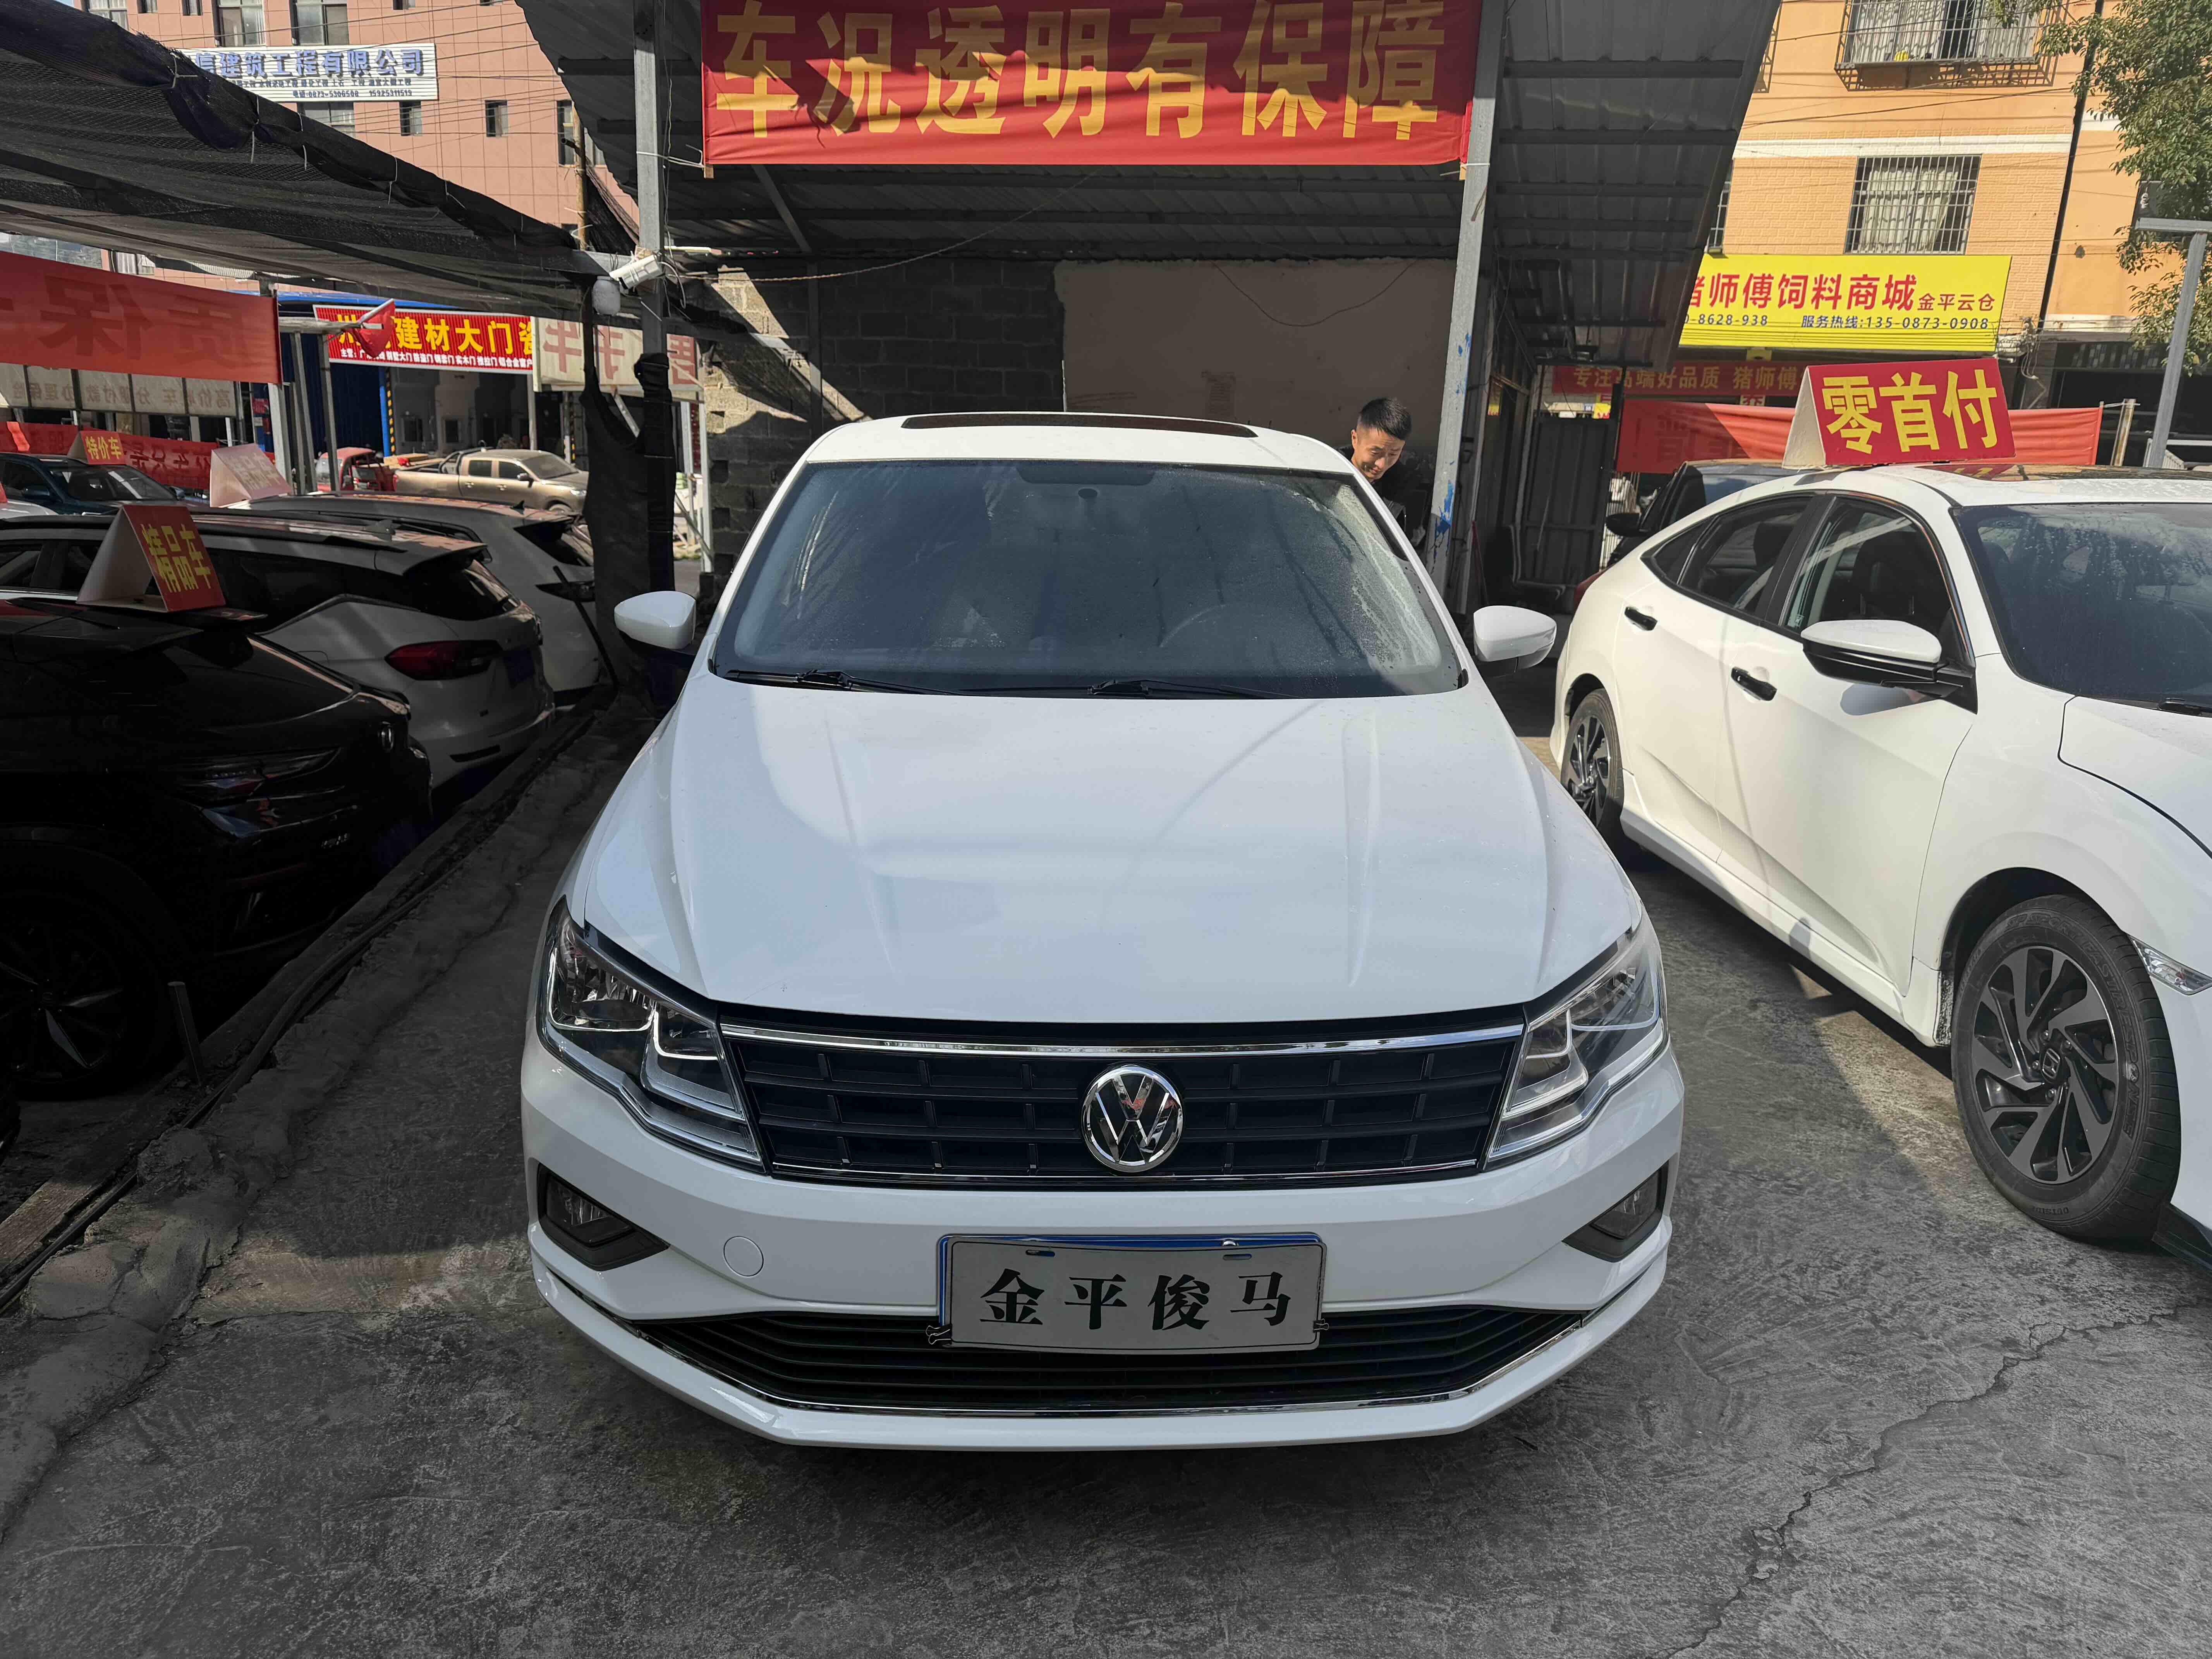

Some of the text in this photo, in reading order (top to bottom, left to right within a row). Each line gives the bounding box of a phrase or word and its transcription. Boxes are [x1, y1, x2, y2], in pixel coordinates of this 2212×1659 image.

[716, 1, 1446, 140] 车况透明有保障
[1917, 293, 1996, 311] 金平云仓
[1822, 369, 1997, 454] 零首付
[85, 436, 122, 460] 特价车
[140, 524, 211, 592] 精品车
[980, 1268, 1291, 1331] 金平俊马
